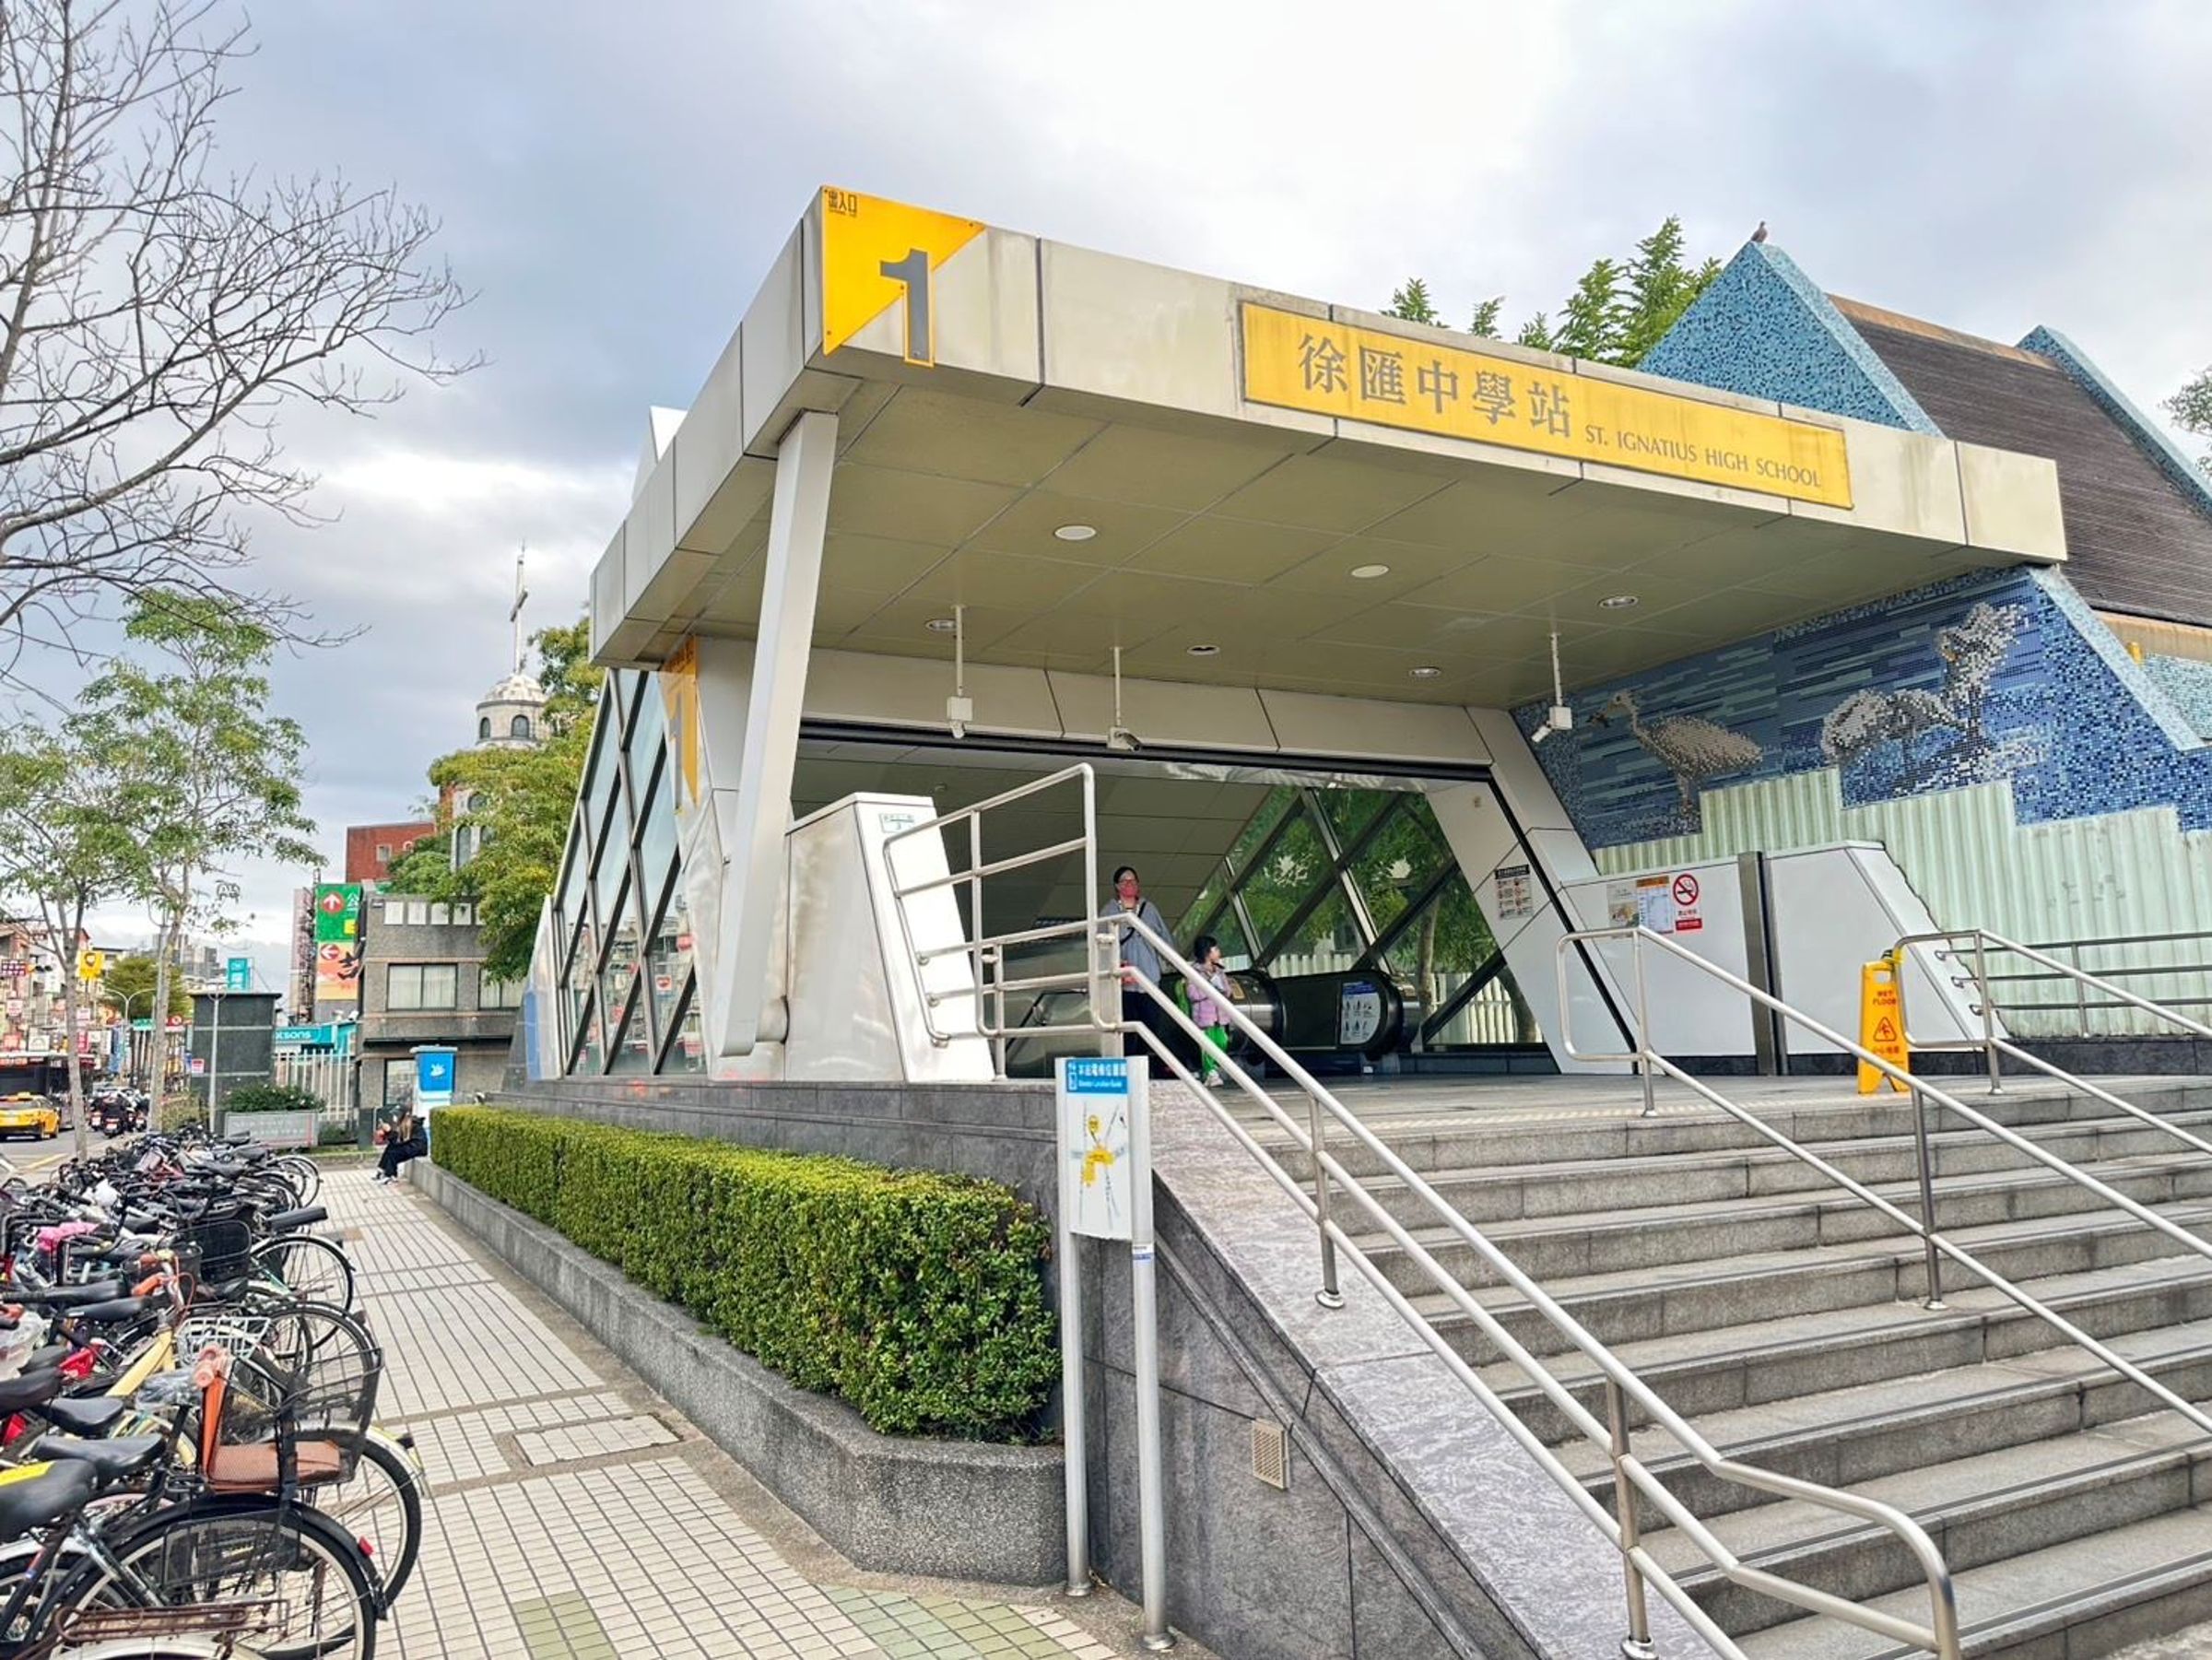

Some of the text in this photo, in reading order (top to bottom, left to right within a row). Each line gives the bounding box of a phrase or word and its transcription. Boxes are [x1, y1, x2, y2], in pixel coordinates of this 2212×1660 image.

[828, 191, 857, 213] 出入口
[879, 247, 930, 360] 1
[1298, 332, 1571, 438] 徐匯中學站
[1584, 423, 1821, 488] ST. IGNATIUS HIGH SCHOOL
[1872, 997, 1897, 1006] FLOOR
